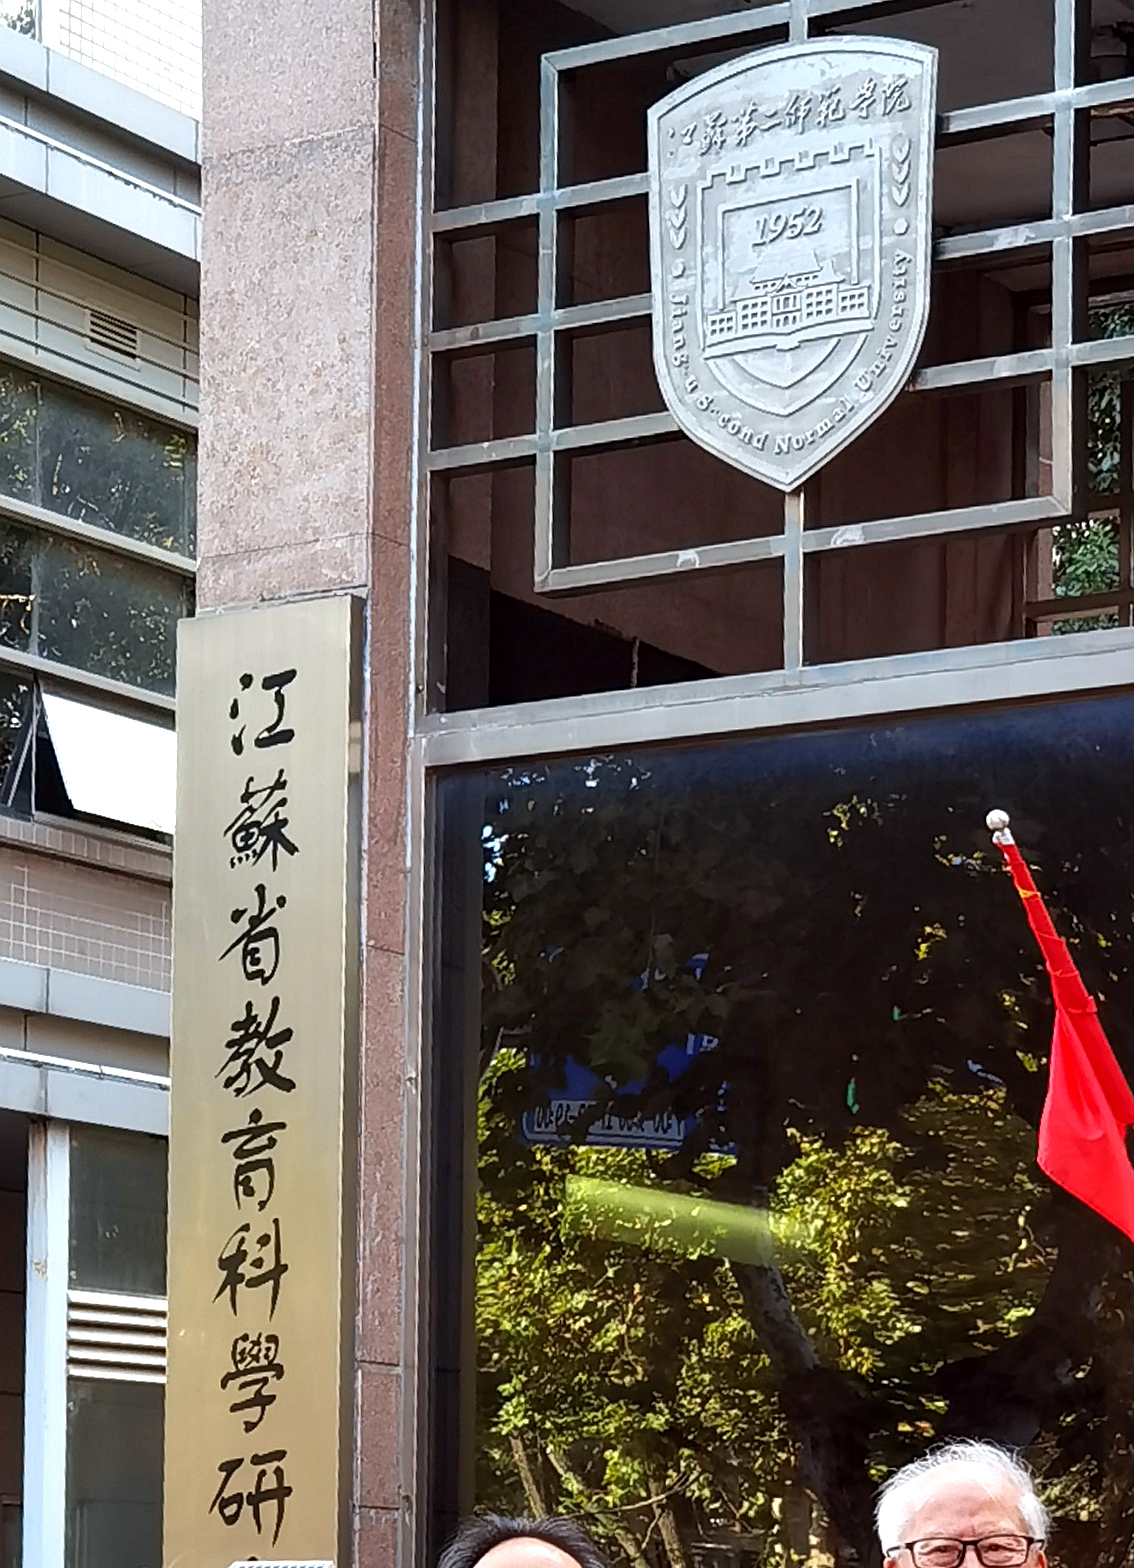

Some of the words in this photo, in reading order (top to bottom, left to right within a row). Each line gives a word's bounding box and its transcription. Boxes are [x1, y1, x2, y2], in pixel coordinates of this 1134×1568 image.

[752, 206, 823, 248] 1952
[670, 294, 699, 394] Jiangu
[696, 393, 769, 451] Scond
[773, 393, 856, 456] Normal
[854, 249, 913, 393] University
